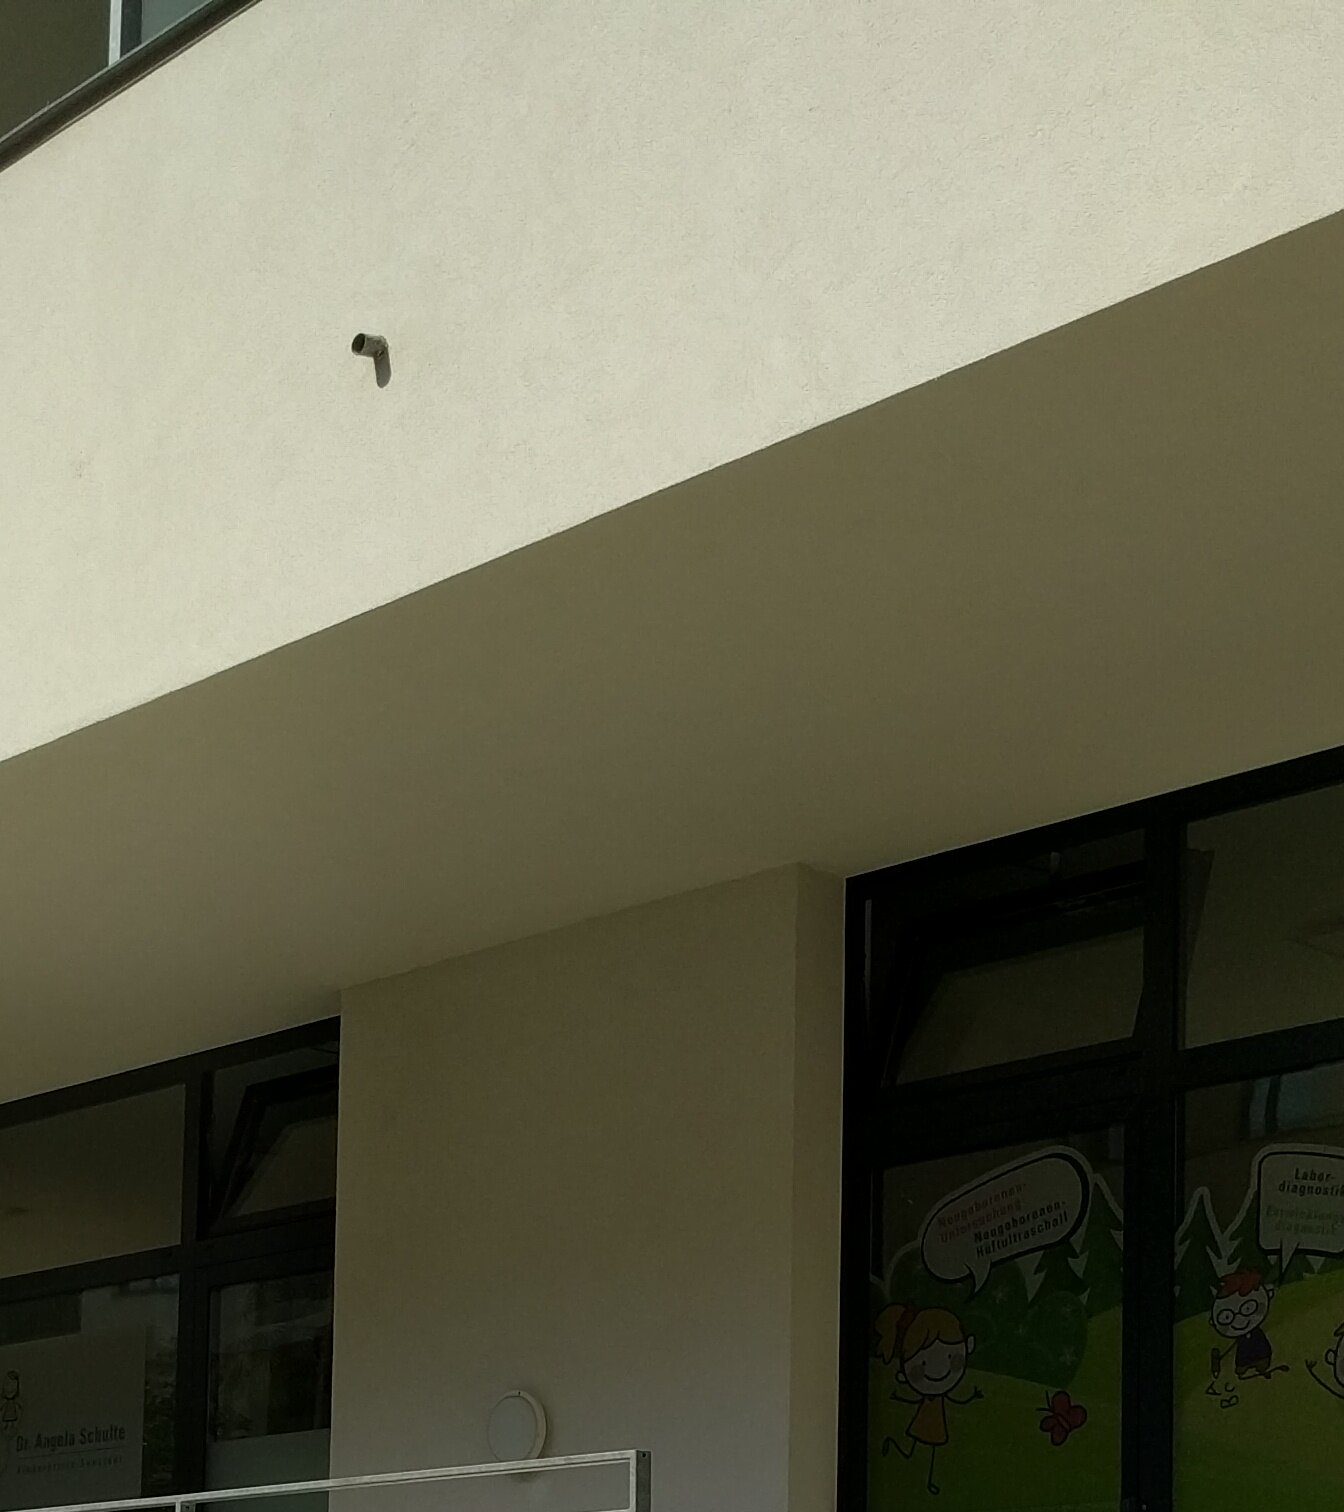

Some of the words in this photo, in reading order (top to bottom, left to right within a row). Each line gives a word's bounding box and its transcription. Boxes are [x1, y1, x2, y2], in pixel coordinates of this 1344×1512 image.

[1295, 1168, 1335, 1182] Labor-
[35, 1430, 75, 1452] Angela
[79, 1424, 125, 1445] Schulte
